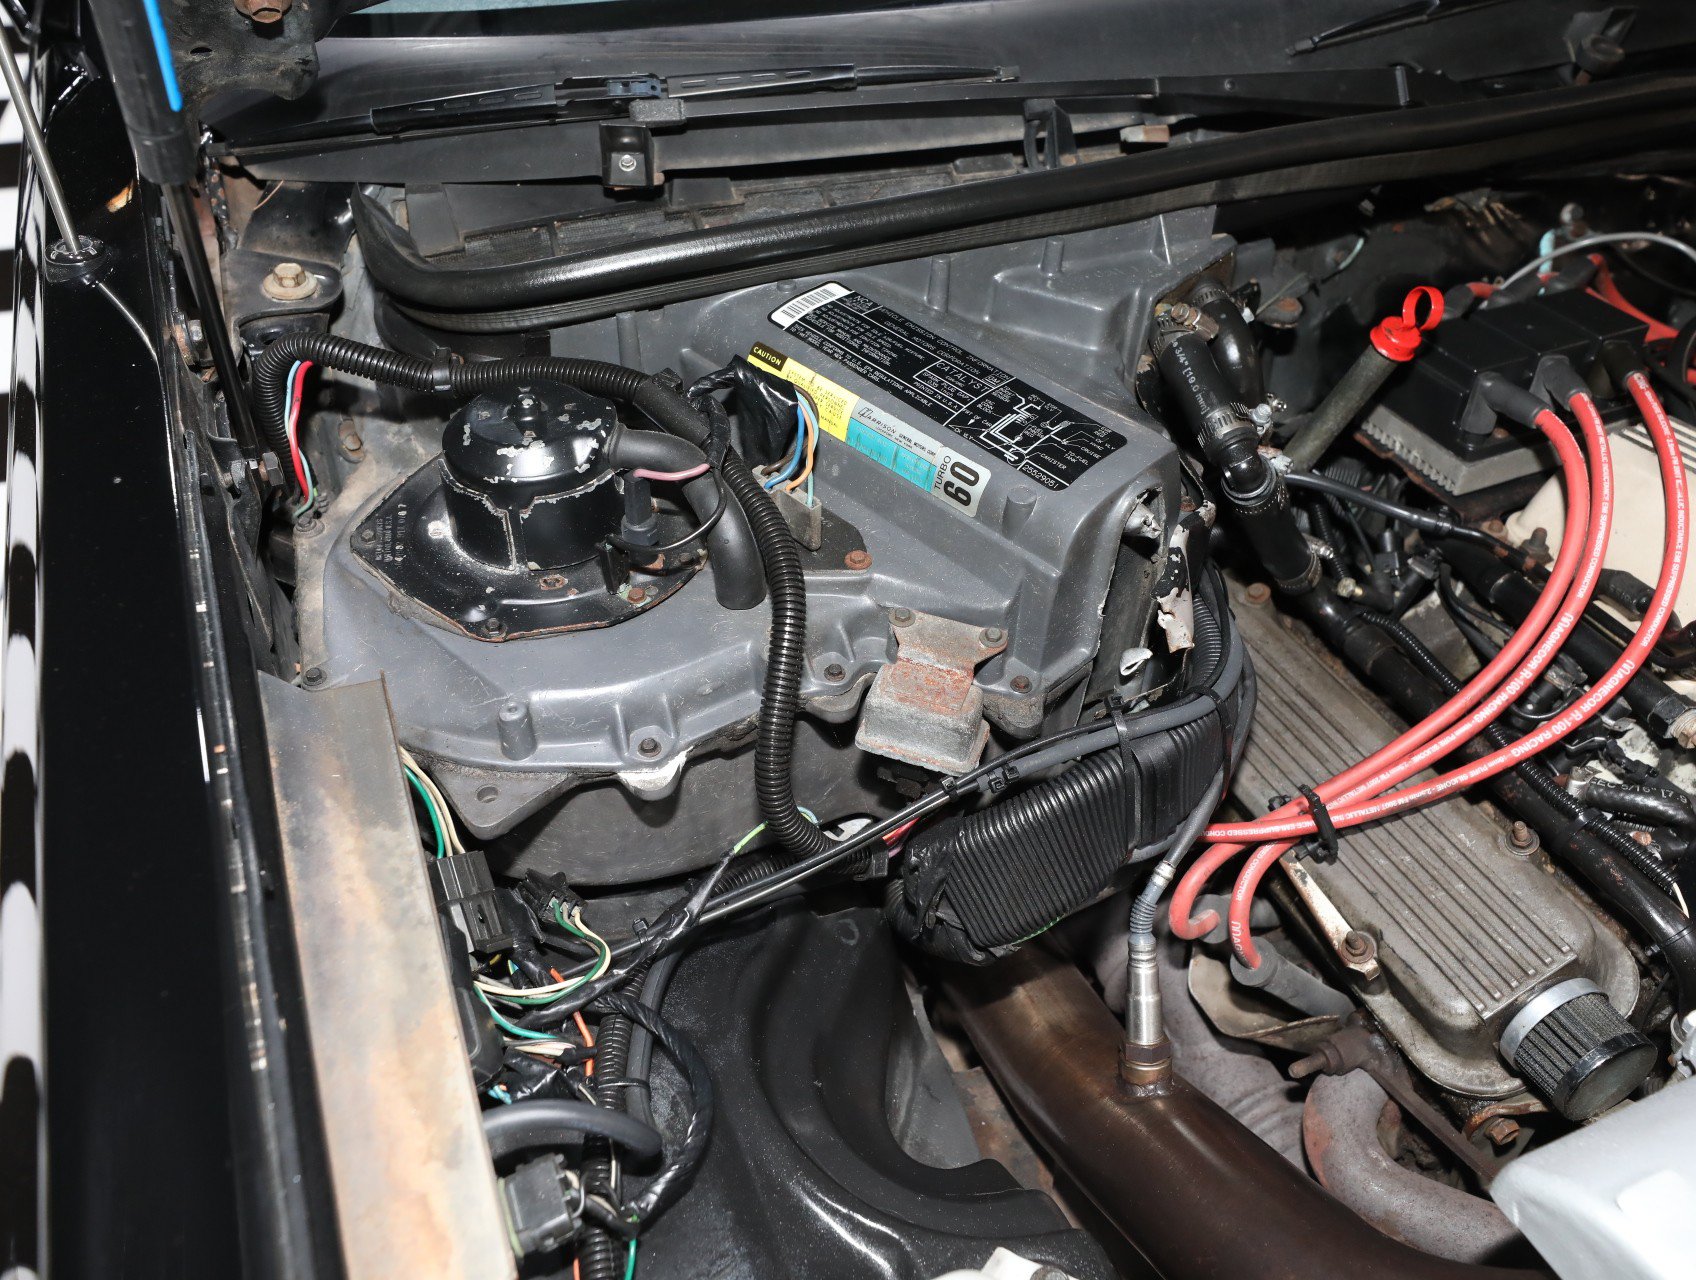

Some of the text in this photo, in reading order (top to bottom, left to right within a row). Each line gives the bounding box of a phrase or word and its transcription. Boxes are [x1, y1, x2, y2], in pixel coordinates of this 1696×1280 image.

[884, 320, 909, 337] GENERAL
[911, 336, 936, 350] MOTORS
[905, 321, 936, 339] EMISSION
[936, 339, 963, 355] CONTROL
[966, 355, 1010, 380] INFORMATION
[753, 346, 781, 366] CAUTION
[913, 381, 934, 395] PRINTED
[936, 361, 989, 392] CATALYST
[934, 455, 951, 490] TURBO
[1022, 464, 1058, 488] 25529051
[1040, 453, 1067, 470] CANISTER
[943, 461, 980, 507] 60
[1593, 514, 1607, 557] SUPPRESSED
[1676, 509, 1685, 550] INDUCTANCE
[1576, 557, 1598, 598] CONDUCTOR
[1661, 563, 1680, 607] SUPPRESSED
[1528, 612, 1573, 669] MAGNECOR
[1640, 607, 1666, 647] CONDUCTOR
[1505, 668, 1532, 695] R-100
[1580, 660, 1634, 712] MAGNECOR
[1473, 692, 1508, 723] RACING
[1551, 709, 1582, 734] R-100
[1510, 730, 1551, 757] RACING
[1436, 773, 1469, 791] SILICONE
[1236, 858, 1260, 901] CONDUCTOR
